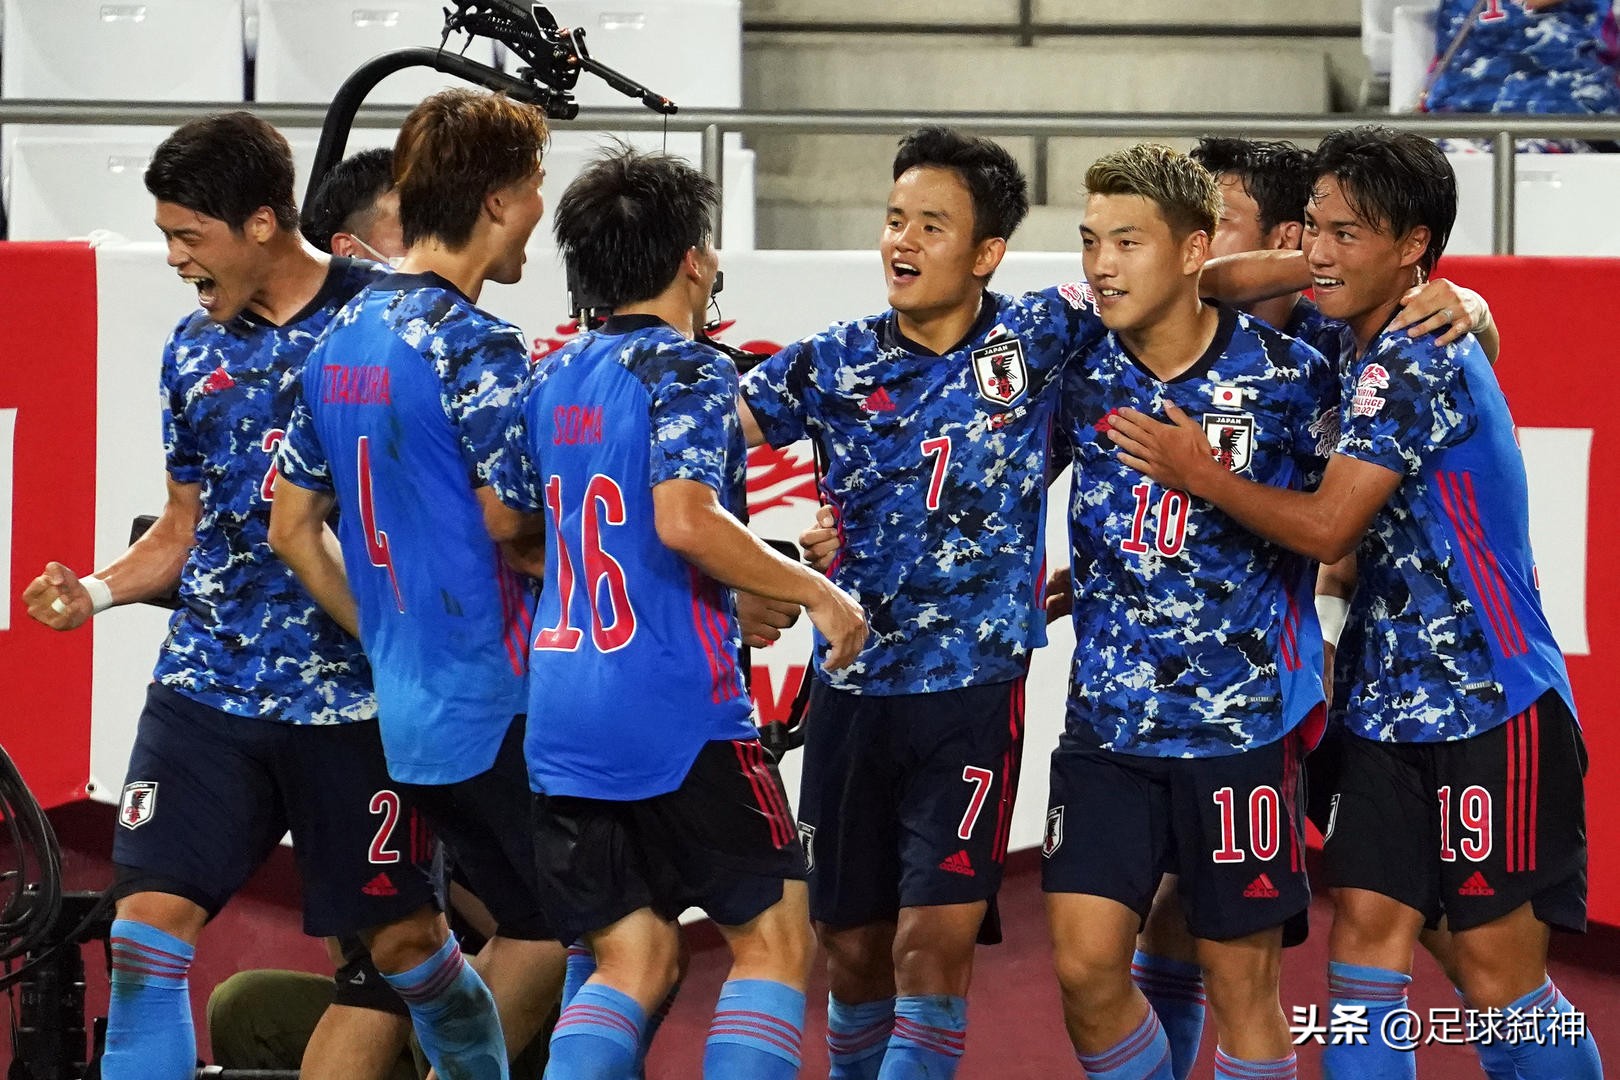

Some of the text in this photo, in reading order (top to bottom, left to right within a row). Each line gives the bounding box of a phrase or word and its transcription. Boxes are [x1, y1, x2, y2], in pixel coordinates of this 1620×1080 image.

[984, 344, 1008, 355] JAPAN
[553, 405, 604, 445] SOMA
[1216, 416, 1242, 425] JAPAN
[920, 435, 952, 511] 7
[357, 435, 405, 614] 4
[1121, 483, 1191, 559] 10
[533, 472, 637, 653] 16
[368, 789, 400, 864] 2
[957, 765, 993, 840] 7
[1213, 785, 1280, 863] 10
[1437, 785, 1492, 862] 19
[1243, 889, 1279, 898] adidas
[1458, 887, 1495, 896] adidas
